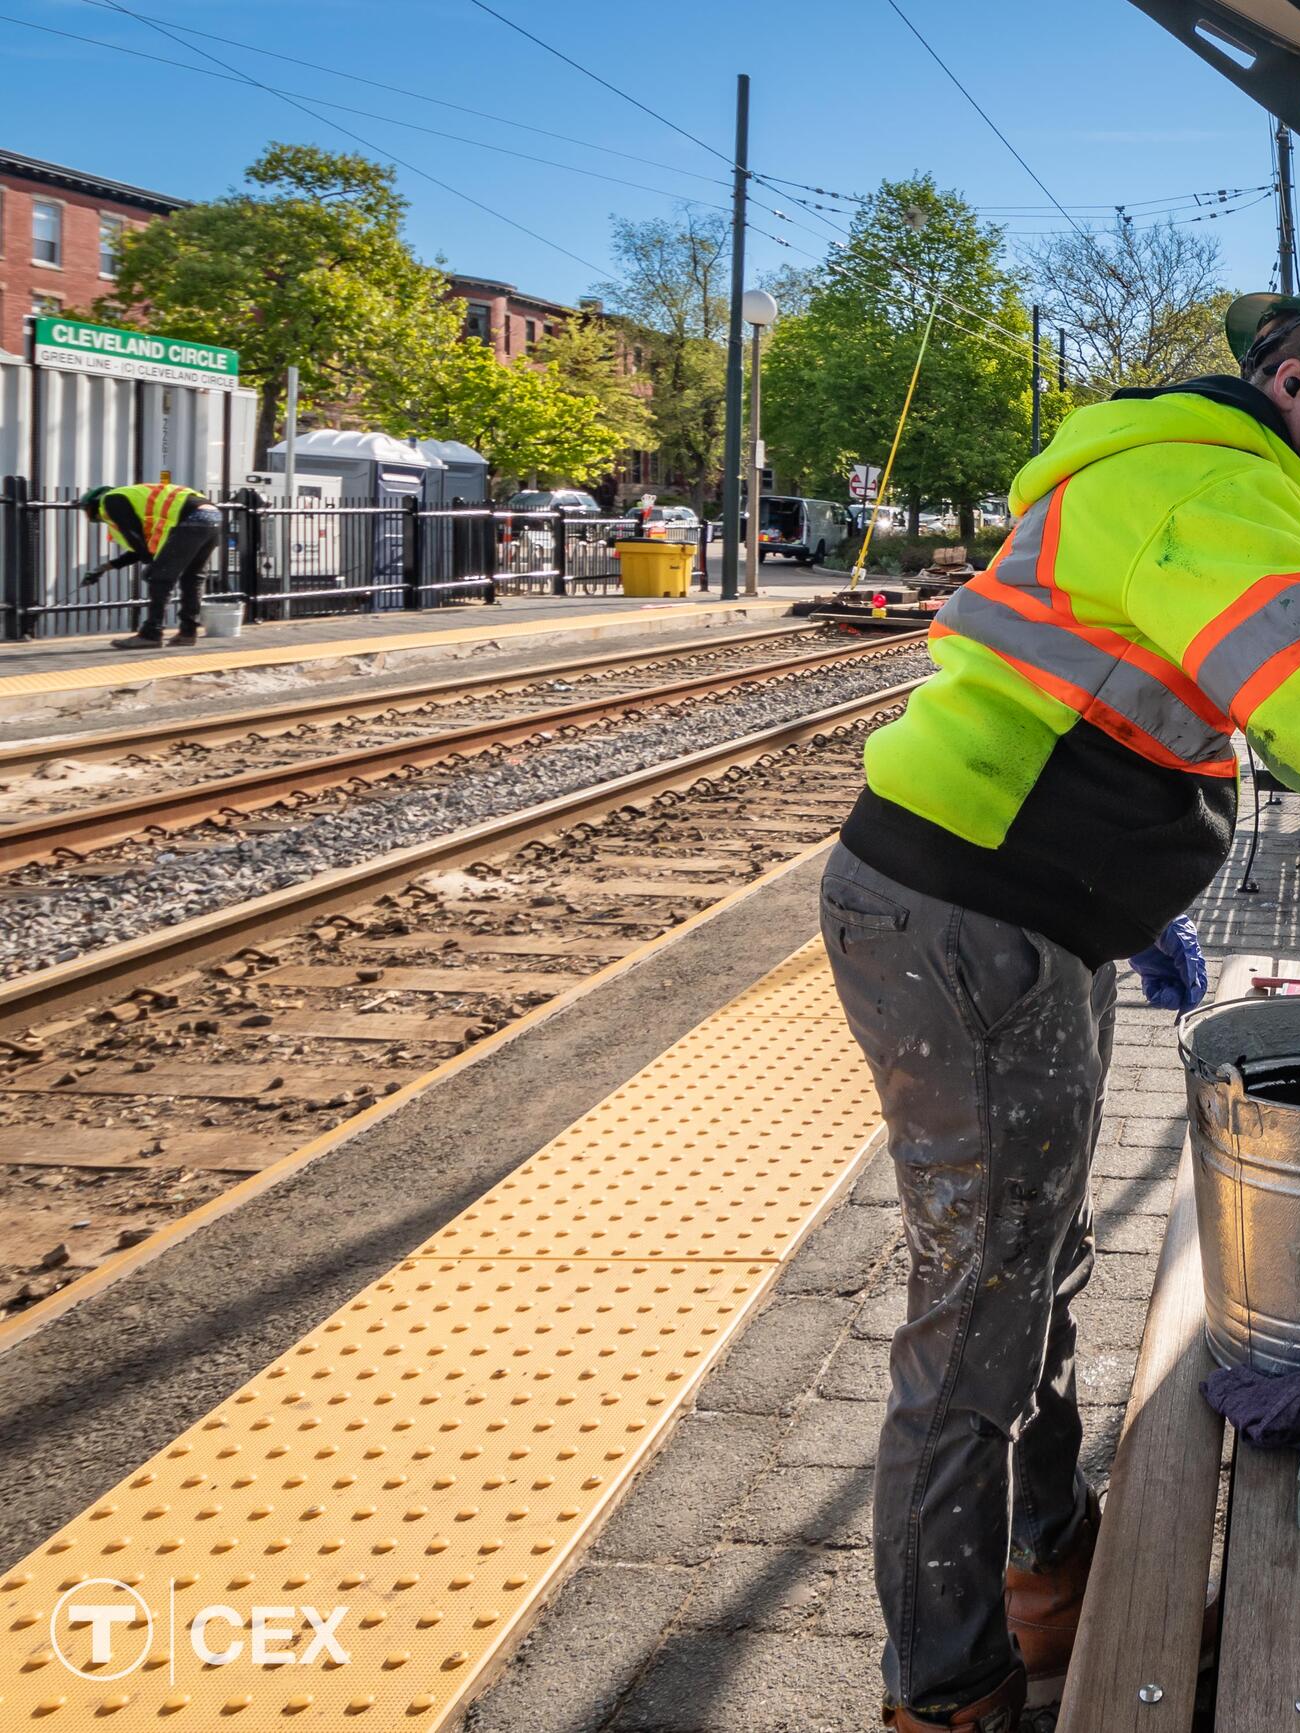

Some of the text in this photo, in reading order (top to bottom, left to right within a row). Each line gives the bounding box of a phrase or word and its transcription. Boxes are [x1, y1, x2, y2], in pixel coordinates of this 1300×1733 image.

[52, 324, 228, 371] CLEVELAND CIRCLE
[41, 350, 82, 366] GREEN
[86, 356, 111, 370] LINE
[139, 364, 198, 383] CLEVELAND
[200, 374, 235, 388] CIRCLE
